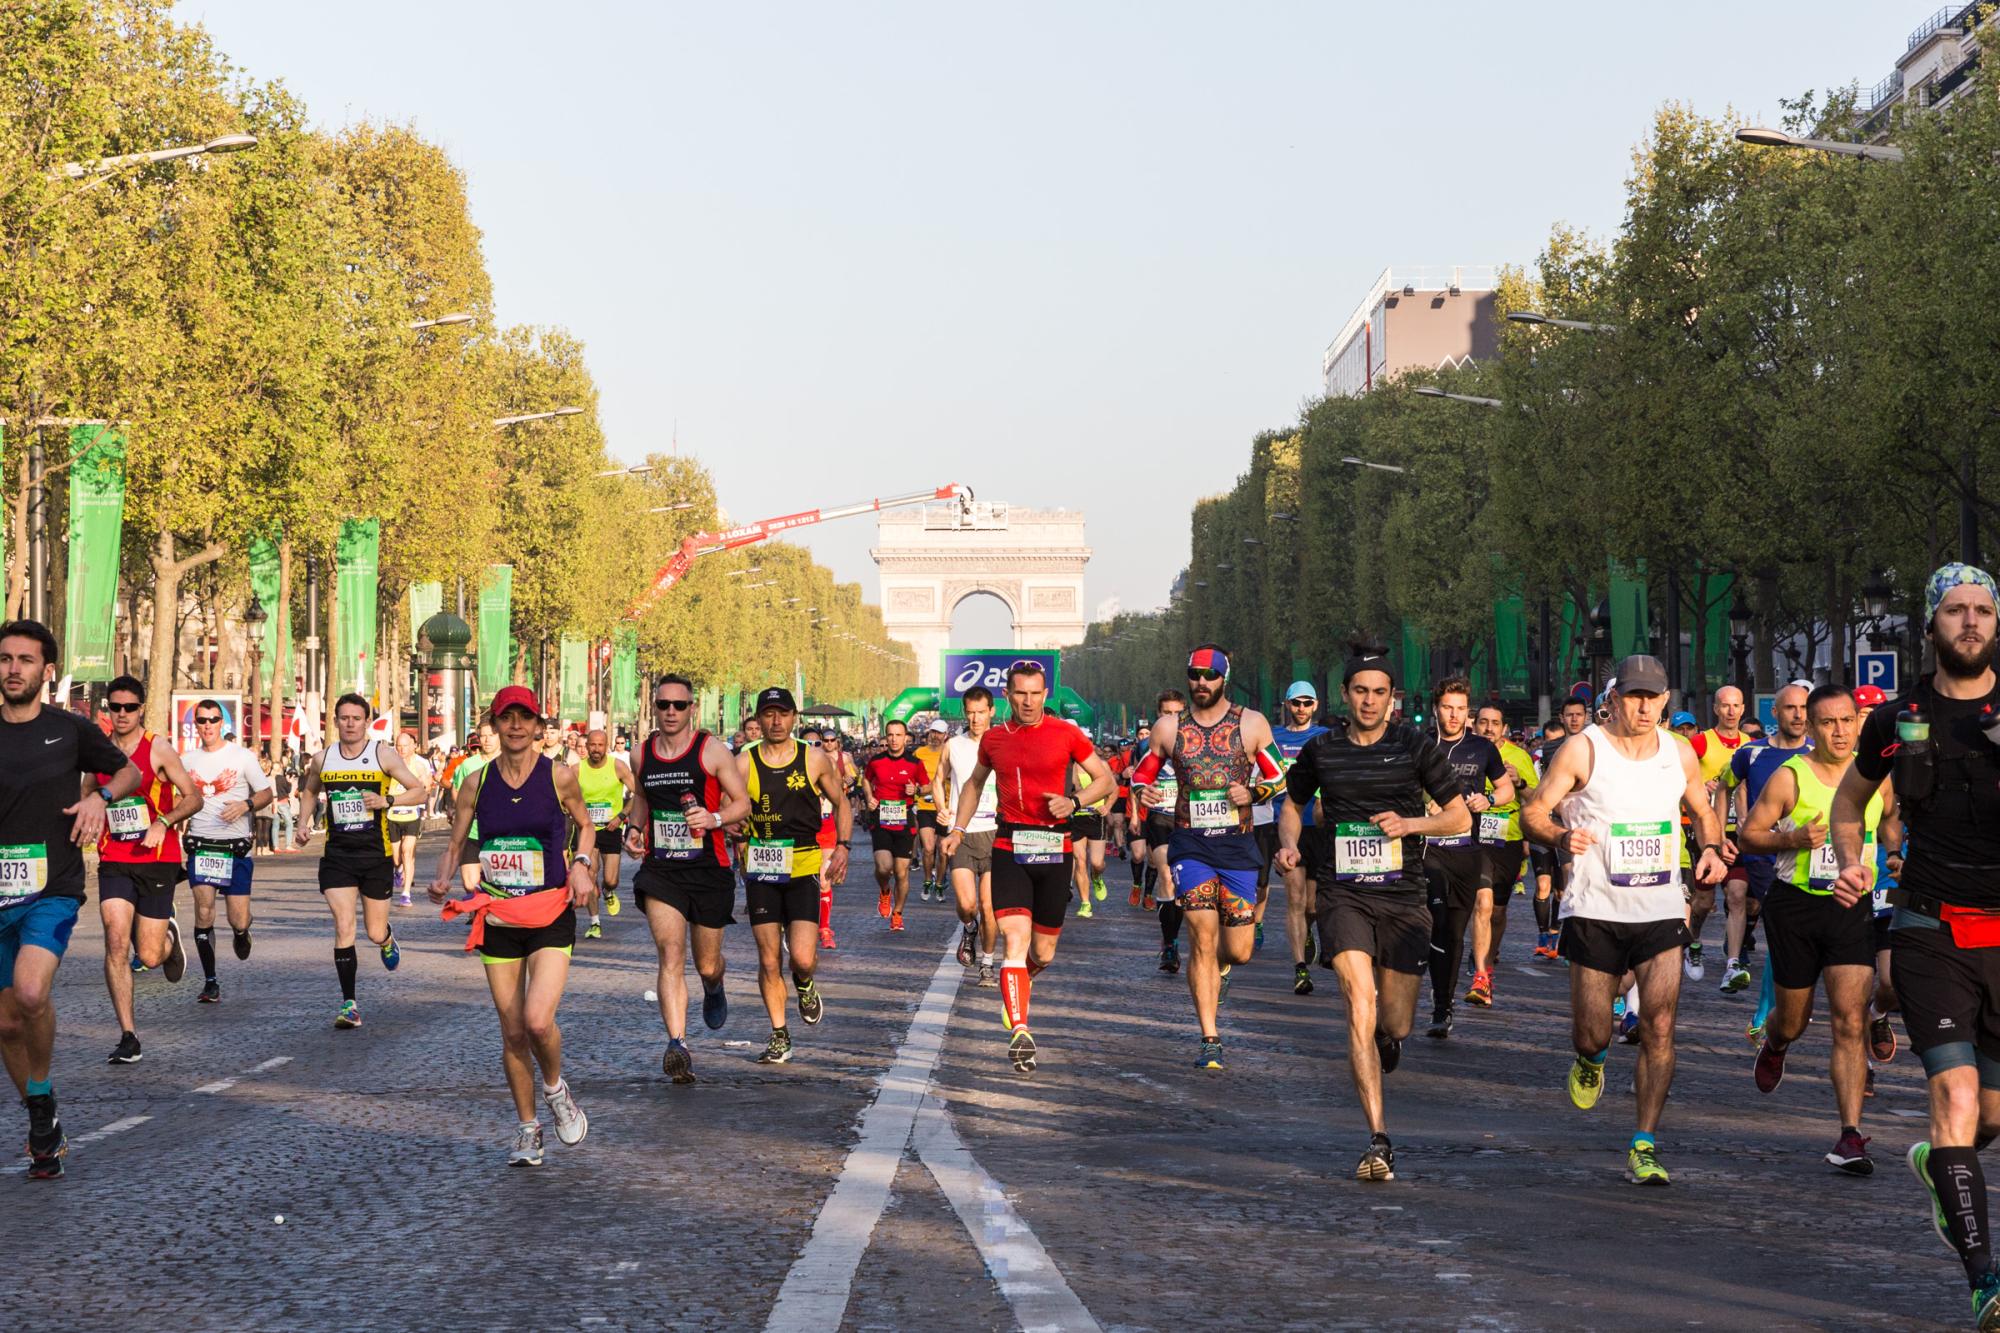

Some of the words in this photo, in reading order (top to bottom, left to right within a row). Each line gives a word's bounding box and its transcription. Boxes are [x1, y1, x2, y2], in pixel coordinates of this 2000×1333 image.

[727, 524, 762, 541] LOXAM
[984, 667, 1009, 688] as
[1868, 660, 1884, 684] P
[362, 772, 375, 780] tri
[647, 771, 690, 780] MANCHESTER
[644, 779, 694, 787] FRONTRUNNERS
[337, 801, 363, 814] 11536
[1195, 801, 1227, 816] 13446
[111, 808, 138, 822] 10840
[660, 823, 688, 838] 11522
[1345, 839, 1382, 857] 11651
[1620, 838, 1660, 857] 13968
[491, 853, 523, 870] 9241
[753, 848, 783, 862] 34838
[199, 857, 225, 869] 20057
[1363, 874, 1385, 882] asics
[1640, 875, 1658, 884] asics
[1947, 1164, 1982, 1249] kalenji
